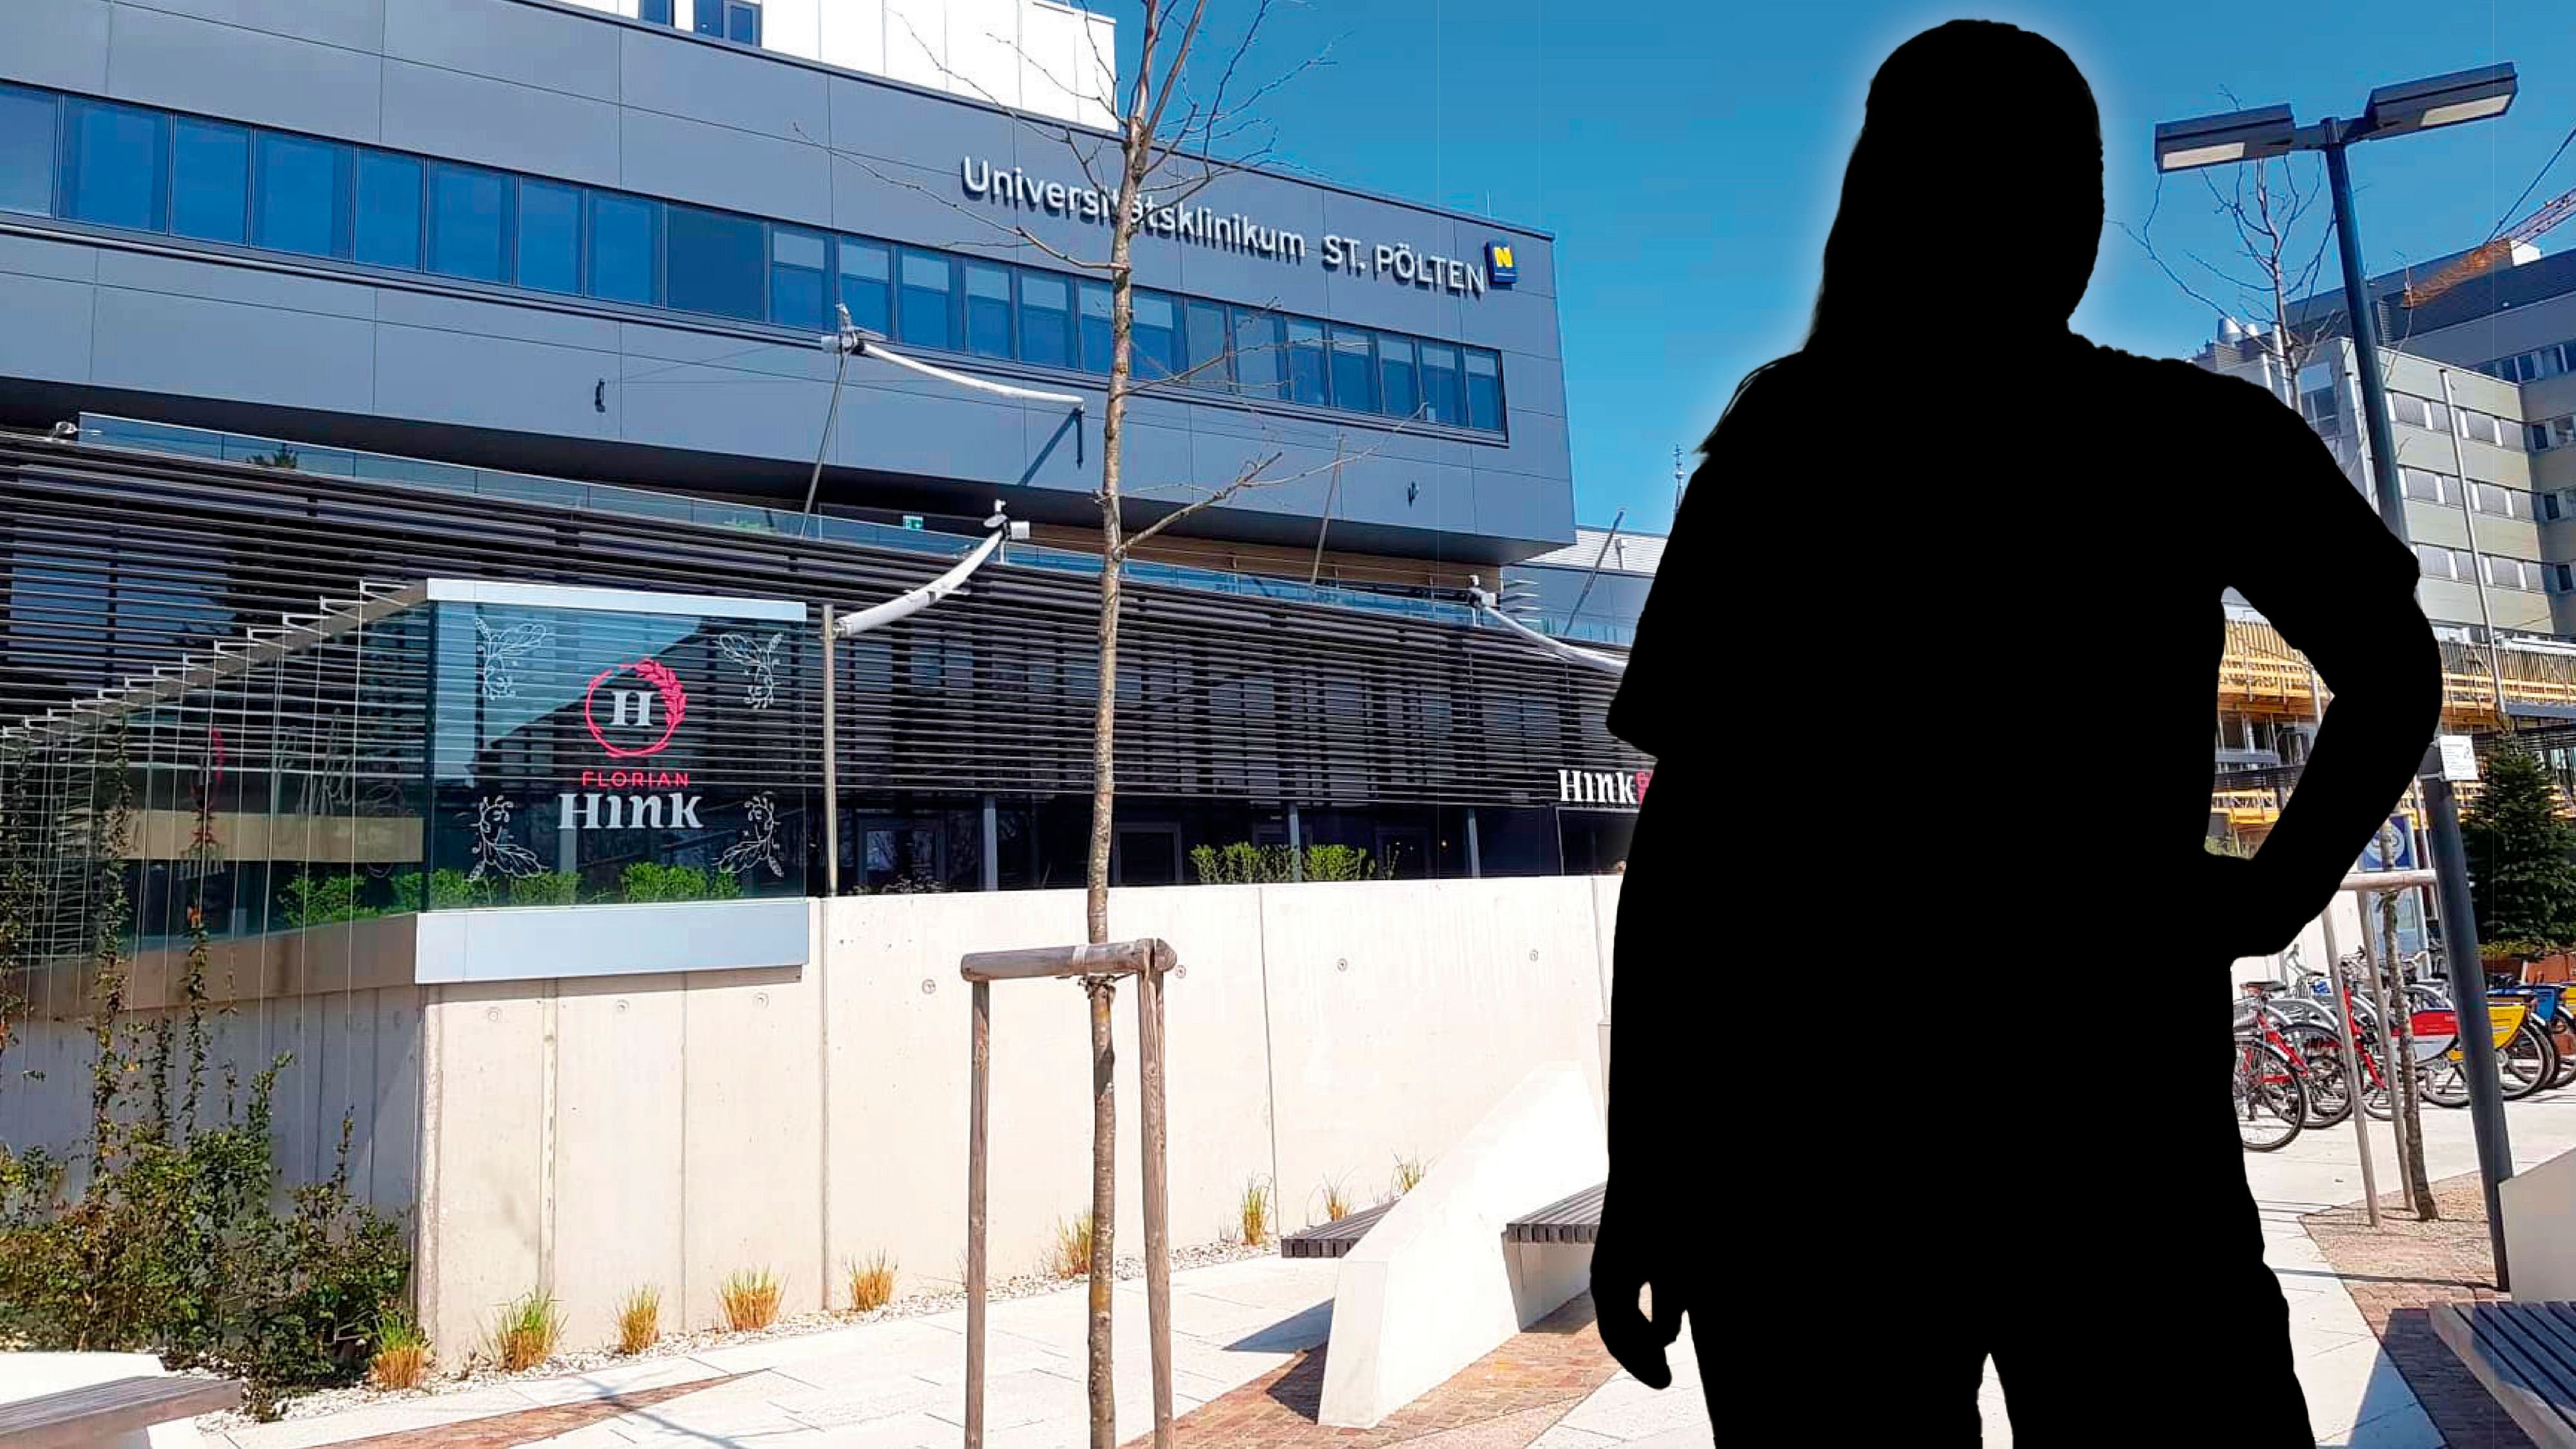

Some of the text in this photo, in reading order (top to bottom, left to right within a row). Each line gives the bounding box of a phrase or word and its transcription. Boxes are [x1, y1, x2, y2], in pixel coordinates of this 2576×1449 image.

[1323, 235, 1367, 270] ST.
[1376, 243, 1484, 293] PÖLTEN
[1493, 246, 1514, 268] N
[611, 690, 658, 726] H
[582, 772, 690, 787] FLORIAN
[1558, 770, 1638, 804] Hink
[558, 793, 703, 829] Hink
